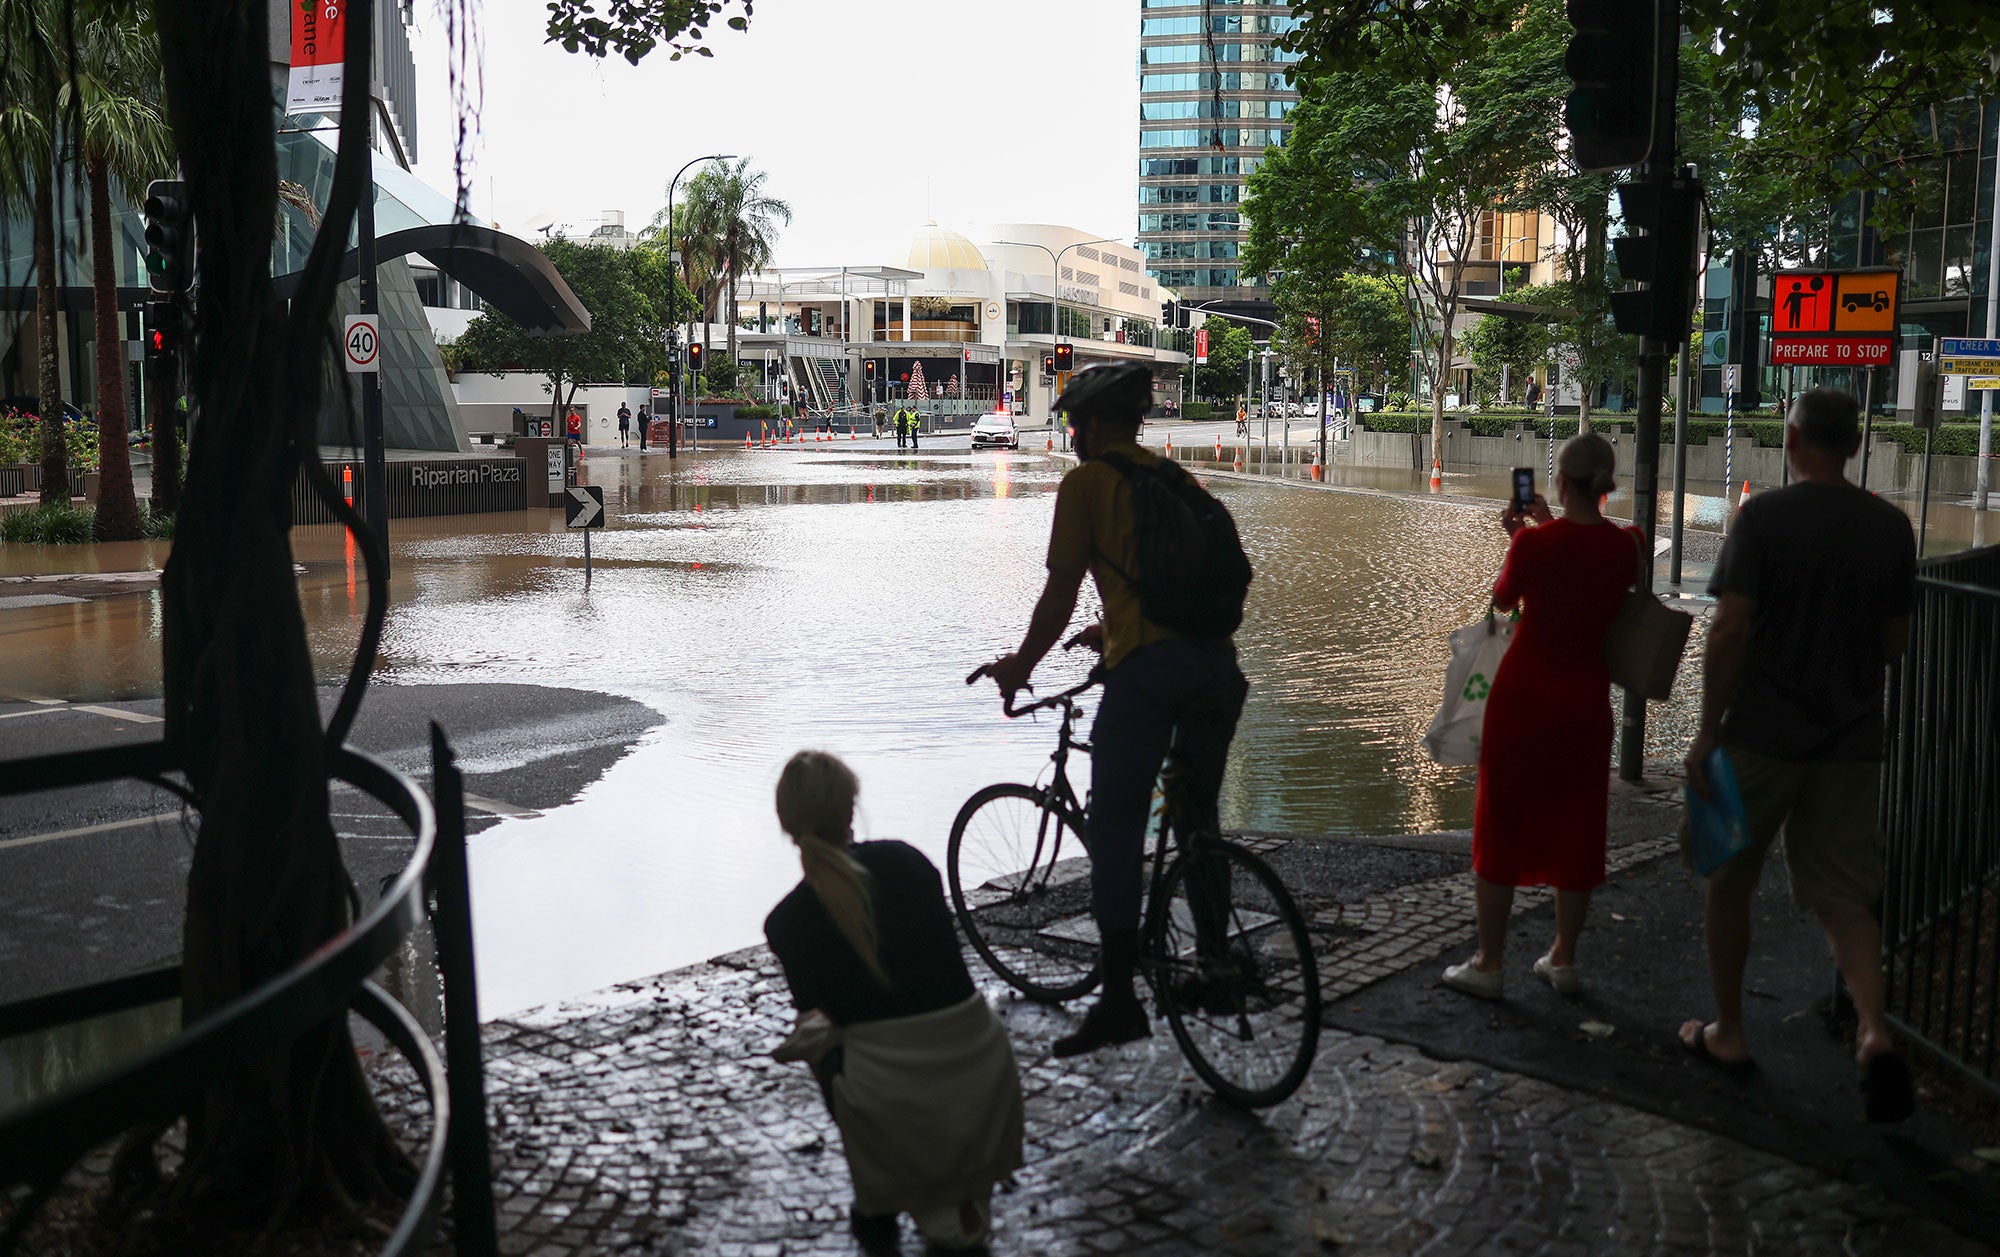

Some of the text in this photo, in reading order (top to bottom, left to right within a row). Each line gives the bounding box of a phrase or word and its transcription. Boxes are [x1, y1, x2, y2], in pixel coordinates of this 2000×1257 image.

[349, 332, 373, 353] 40
[1959, 340, 1990, 351] CREEK
[1776, 345, 1888, 358] PREPARE TO STOP
[549, 450, 561, 459] ONE
[549, 460, 562, 468] WAY
[412, 465, 520, 490] Riparian Plaza
